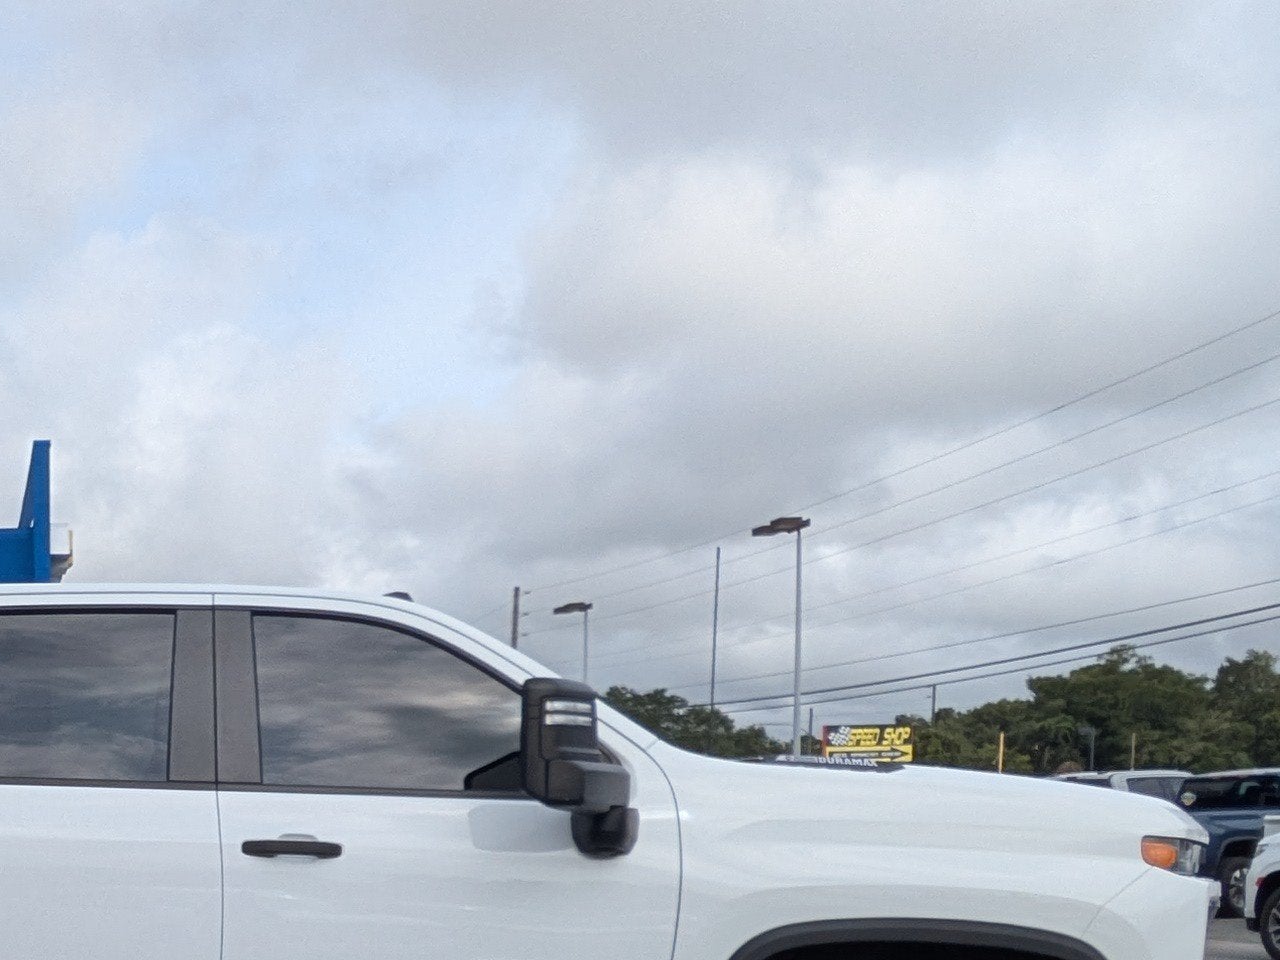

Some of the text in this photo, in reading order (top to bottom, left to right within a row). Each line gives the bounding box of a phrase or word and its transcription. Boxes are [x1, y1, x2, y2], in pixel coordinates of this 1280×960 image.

[847, 727, 911, 747] SPEED SHOP
[818, 757, 878, 767] DURAMAX
